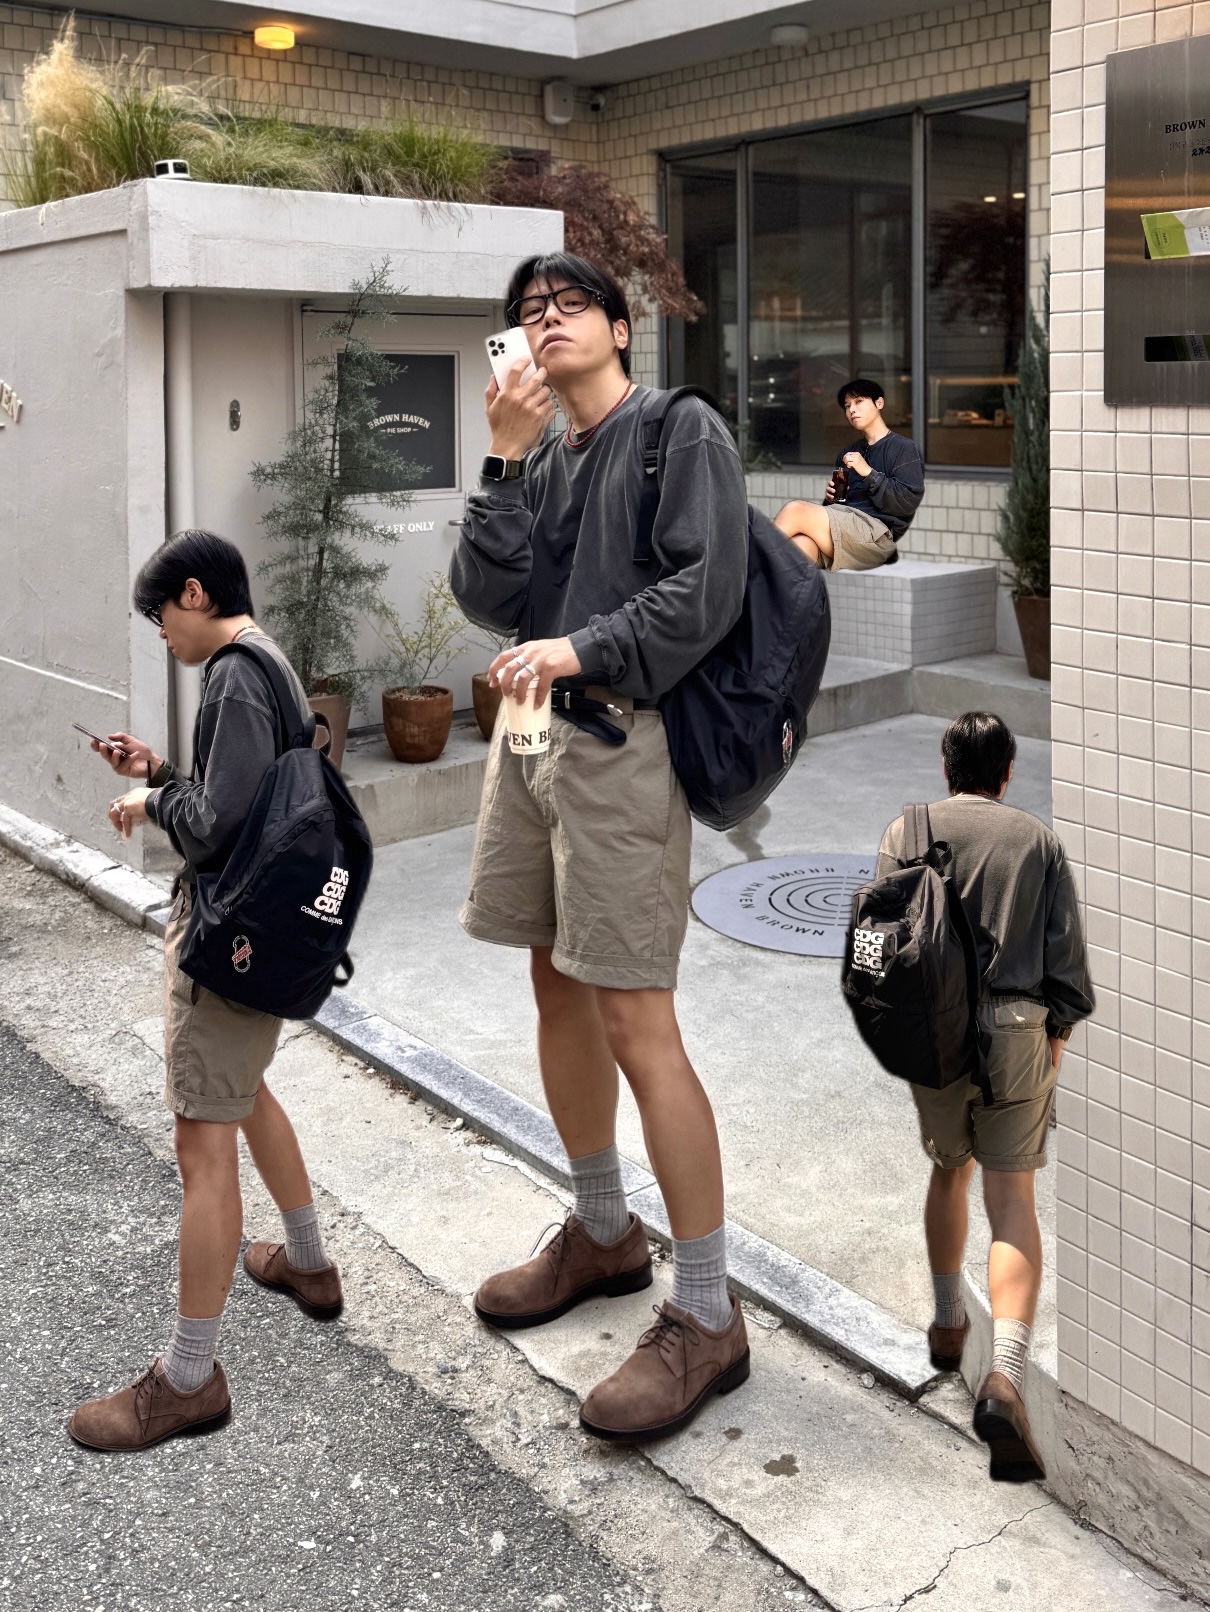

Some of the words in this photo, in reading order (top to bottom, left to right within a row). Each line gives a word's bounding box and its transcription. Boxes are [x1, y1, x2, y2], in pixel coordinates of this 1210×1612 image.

[1164, 119, 1206, 134] BROWN
[402, 413, 431, 429] HAVEN
[407, 520, 434, 533] ONLY
[330, 866, 349, 886] CDG
[322, 881, 347, 901] CDG
[739, 882, 764, 909] HAVEN
[300, 905, 322, 919] COMME
[313, 895, 342, 916] CDG
[755, 914, 825, 936] BROWN
[854, 927, 885, 945] CDG
[853, 940, 883, 957] CDG
[853, 952, 883, 970] CDG
